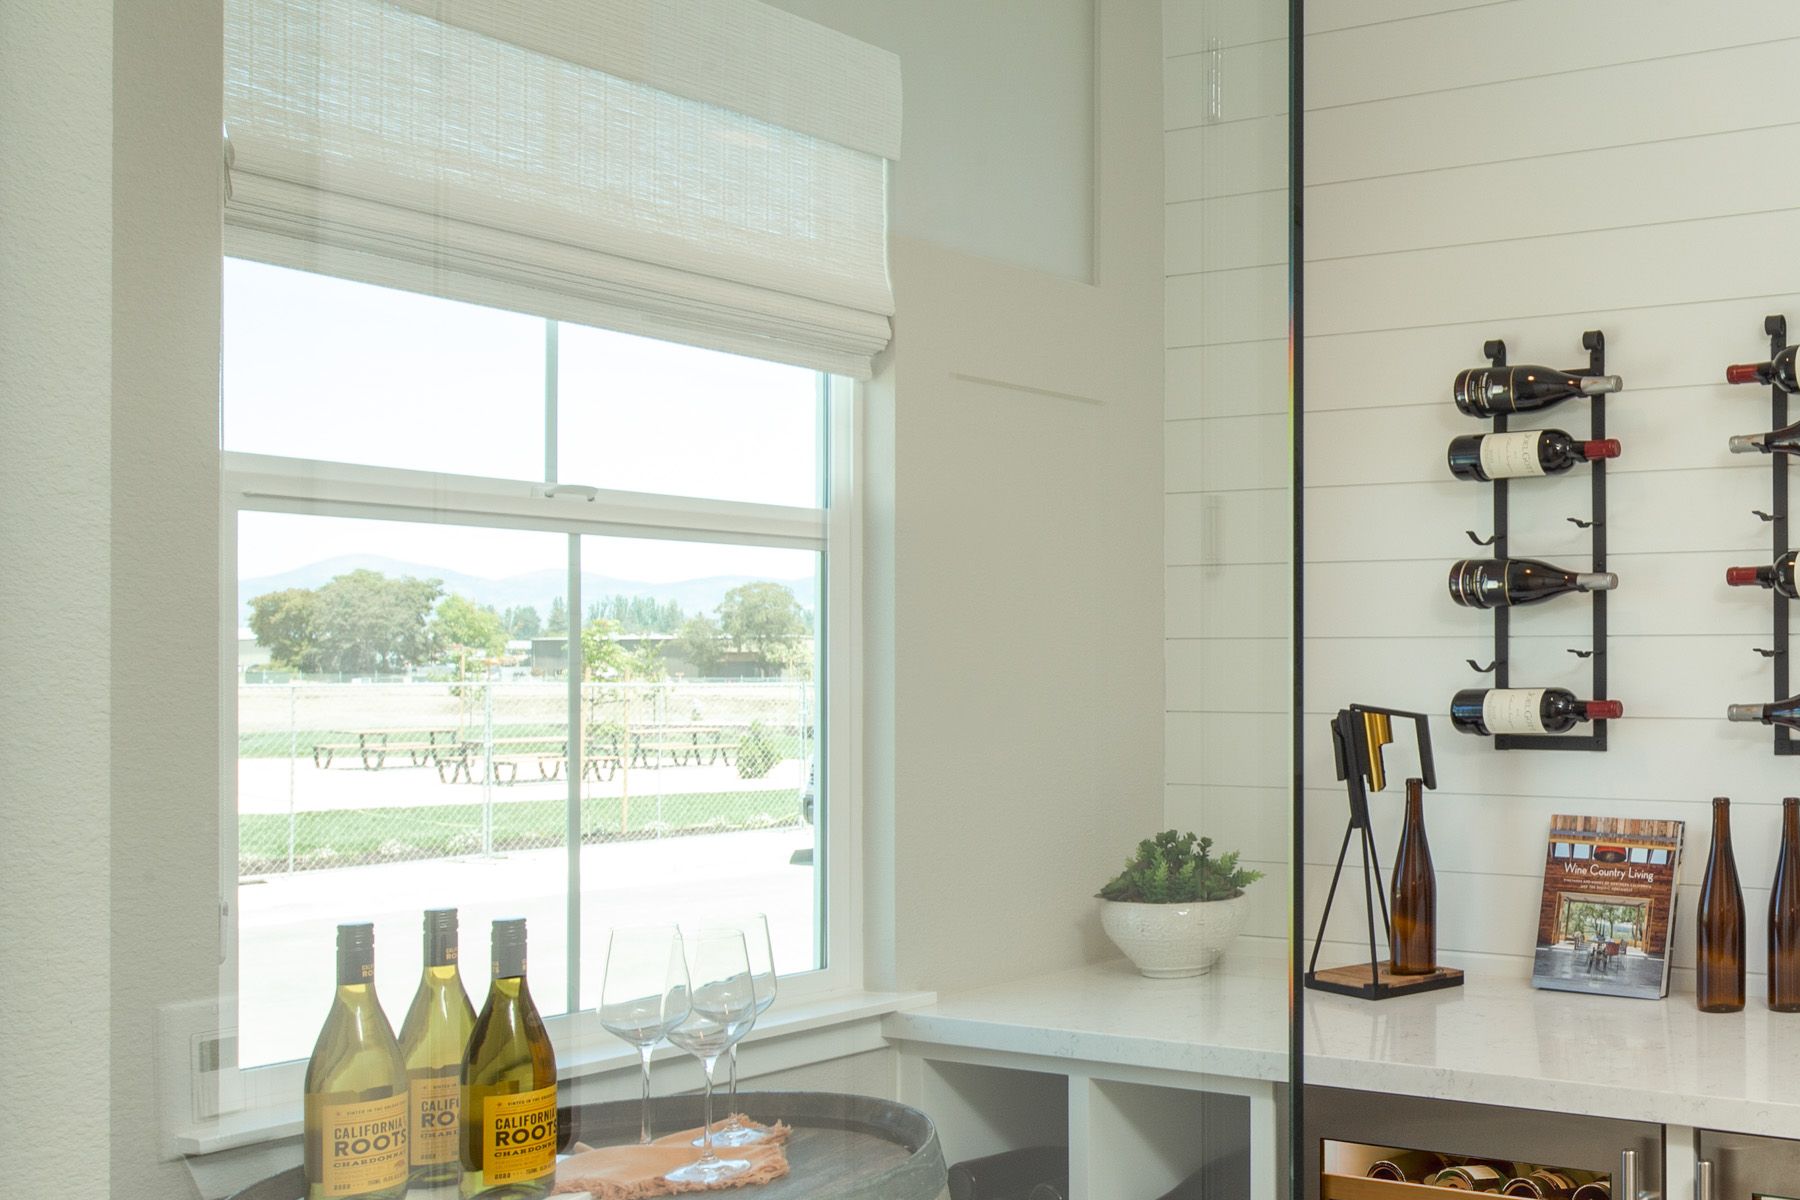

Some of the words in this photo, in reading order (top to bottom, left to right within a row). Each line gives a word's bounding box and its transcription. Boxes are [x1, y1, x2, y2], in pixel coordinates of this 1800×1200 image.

[1564, 862, 1587, 874] Wine
[1590, 864, 1626, 880] Country
[1628, 866, 1654, 882] Living
[334, 1117, 402, 1140] CALIFORNIA
[496, 1108, 556, 1130] CALIFORNIA
[334, 1128, 407, 1157] ROOTS
[496, 1118, 557, 1146] ROOTS
